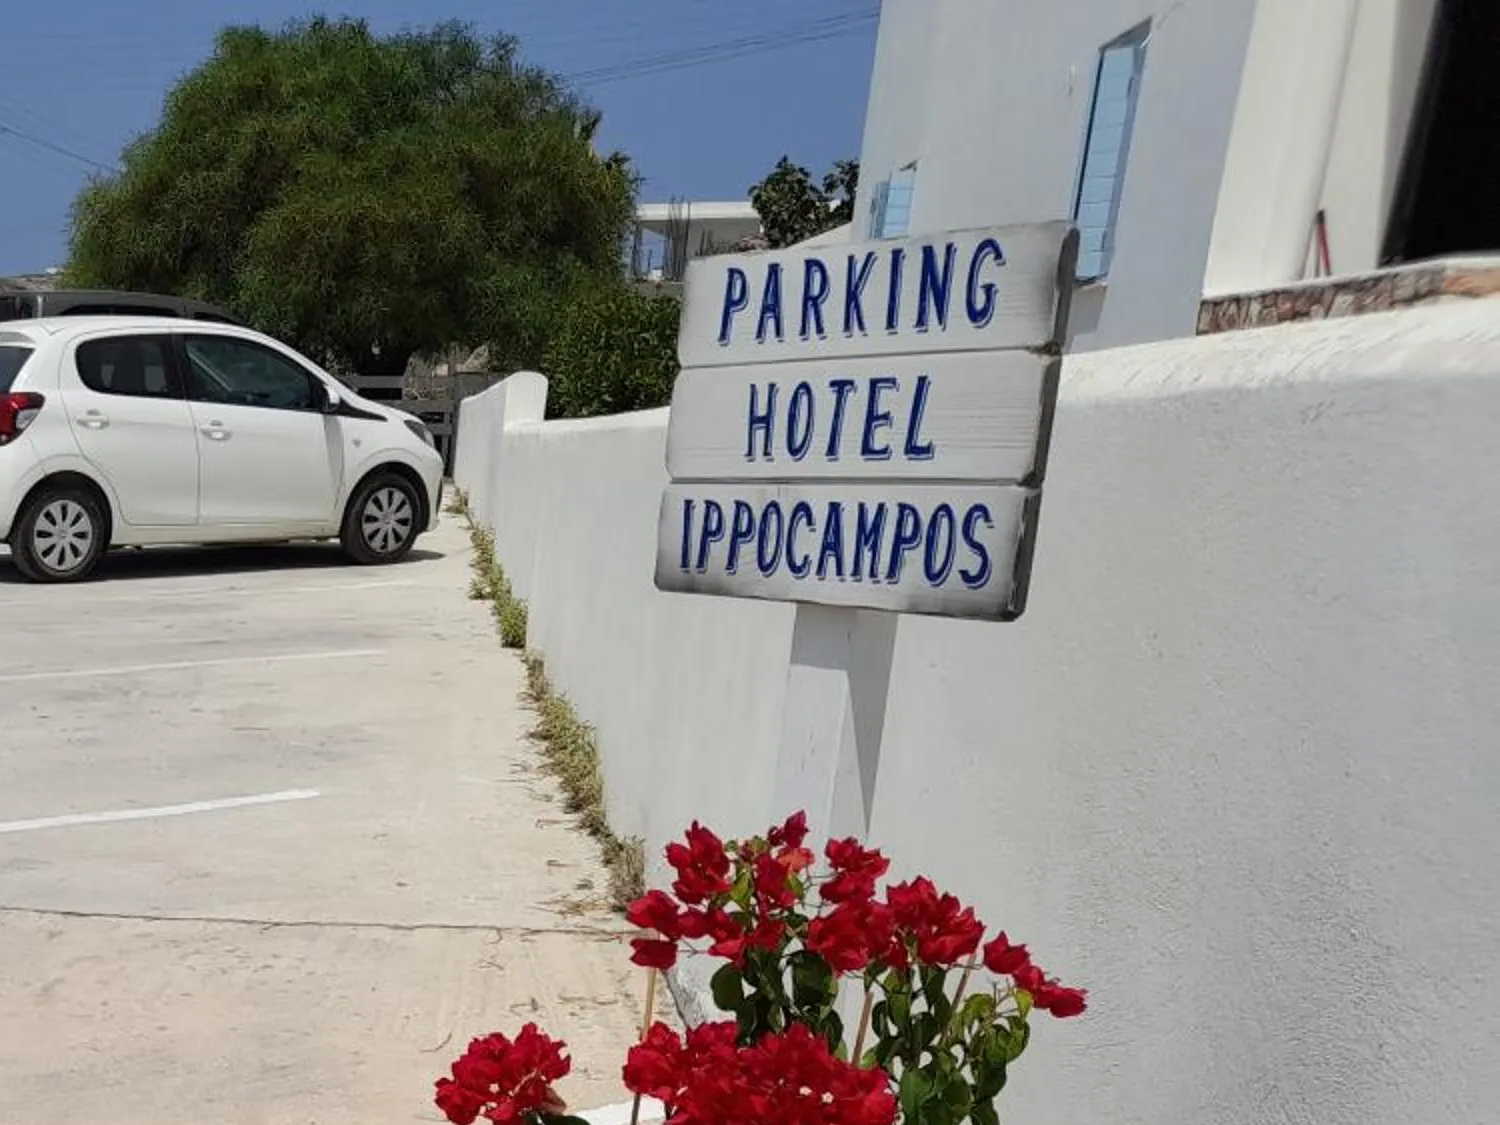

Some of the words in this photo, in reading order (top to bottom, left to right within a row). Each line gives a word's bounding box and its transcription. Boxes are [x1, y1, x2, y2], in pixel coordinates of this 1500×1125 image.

[718, 238, 1006, 346] PARKING
[744, 375, 935, 463] HOTEL
[679, 498, 996, 589] IPPOCAMPOS
